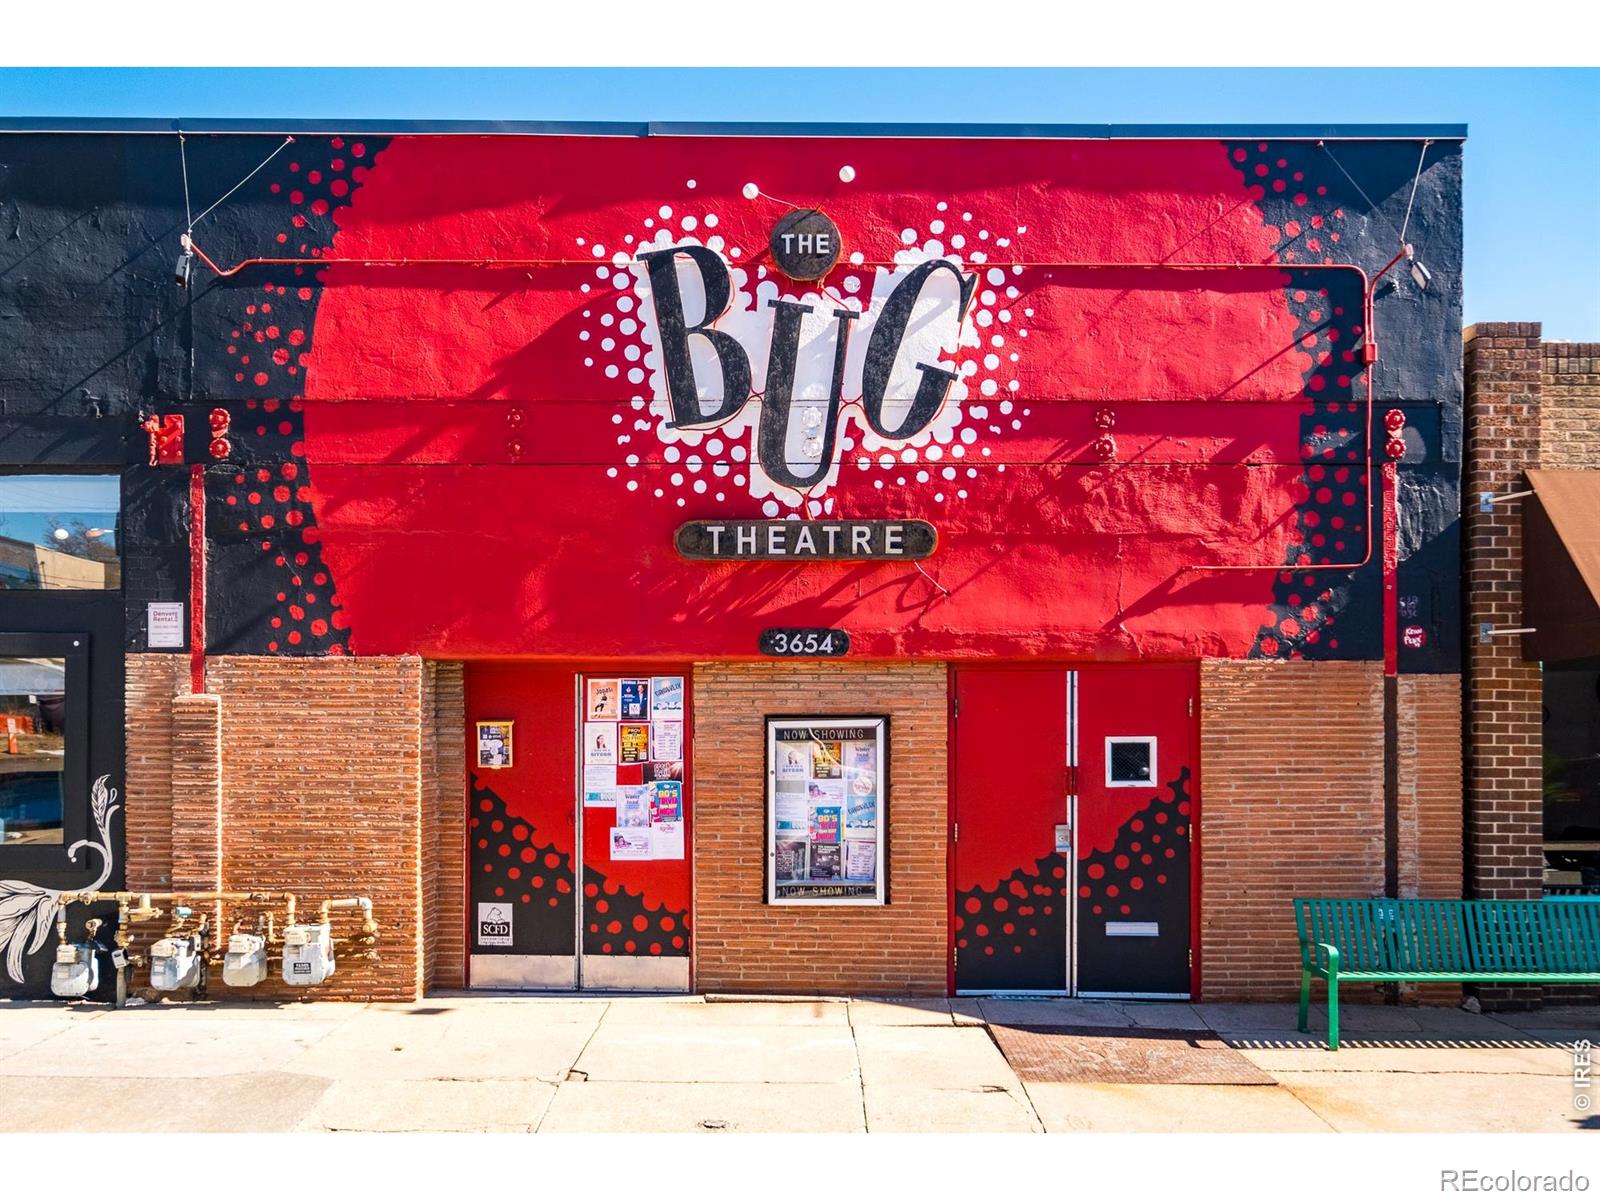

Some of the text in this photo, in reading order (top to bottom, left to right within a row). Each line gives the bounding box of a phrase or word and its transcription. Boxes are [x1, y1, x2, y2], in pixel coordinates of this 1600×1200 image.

[781, 233, 830, 255] THE
[637, 245, 980, 488] BUG
[706, 525, 904, 555] THEATRE
[774, 633, 834, 654] 3654
[783, 729, 865, 740] NOW SHOWING
[782, 886, 863, 896] NOW SHOWING
[483, 924, 509, 935] SCFD
